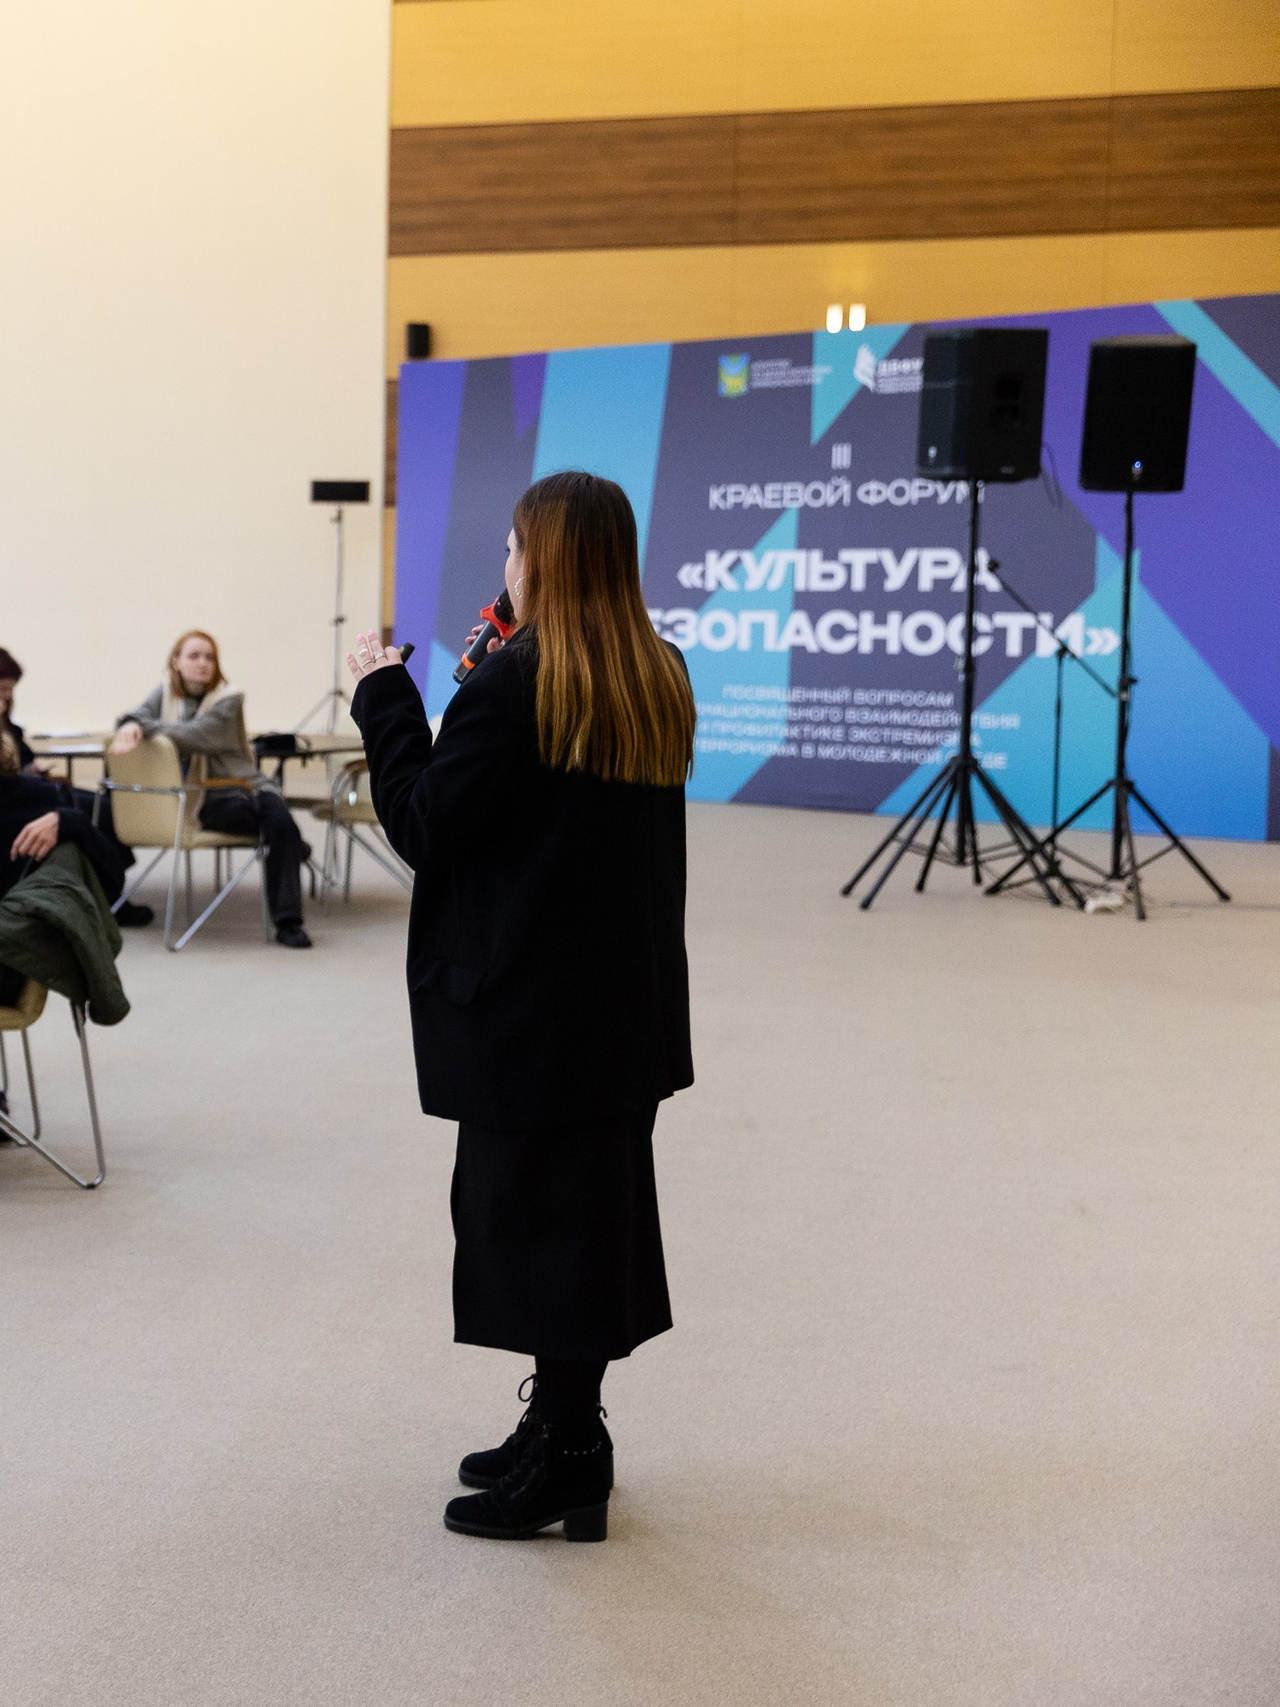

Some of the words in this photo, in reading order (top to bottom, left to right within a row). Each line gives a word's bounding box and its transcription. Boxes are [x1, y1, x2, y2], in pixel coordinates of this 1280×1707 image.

[832, 443, 851, 469] III
[709, 476, 851, 509] КРАЕВОЙ
[857, 478, 984, 505] ФОРУМ
[677, 549, 1001, 592] «КУЛЬТУРА
[647, 608, 1119, 657] ЗОПАСНОСТИ»
[853, 690, 954, 706] ВОПРОСАМ
[697, 704, 843, 722] НАЦИОНАЛЬНОГО
[845, 708, 1019, 728] ВЗАИМОДЕЙТВИЯ
[696, 739, 799, 758] ЕРРОРИЗМА
[801, 743, 816, 758] В
